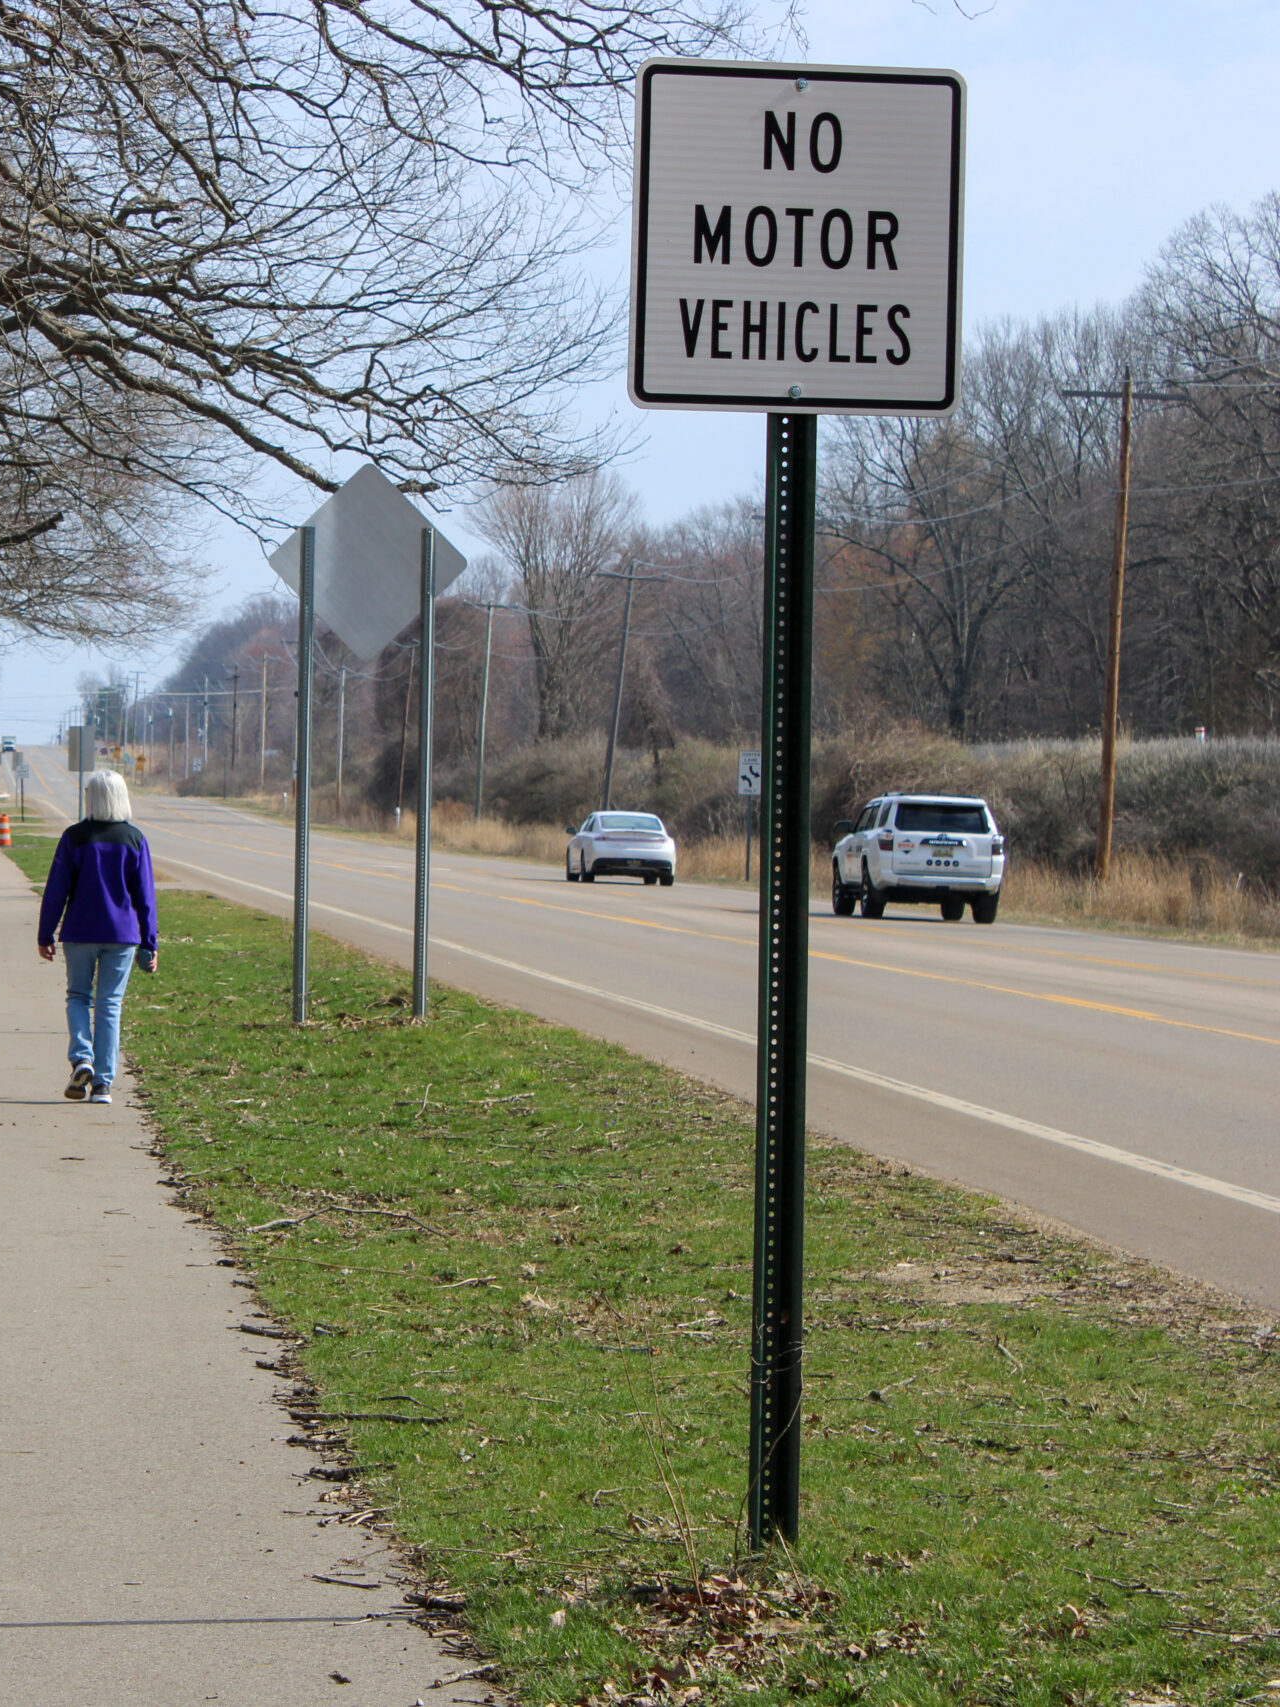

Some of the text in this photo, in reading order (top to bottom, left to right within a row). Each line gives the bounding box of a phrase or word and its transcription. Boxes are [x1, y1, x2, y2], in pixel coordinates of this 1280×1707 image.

[763, 110, 842, 173] NO
[693, 204, 899, 270] MOTOR
[679, 298, 911, 366] VEHICLES
